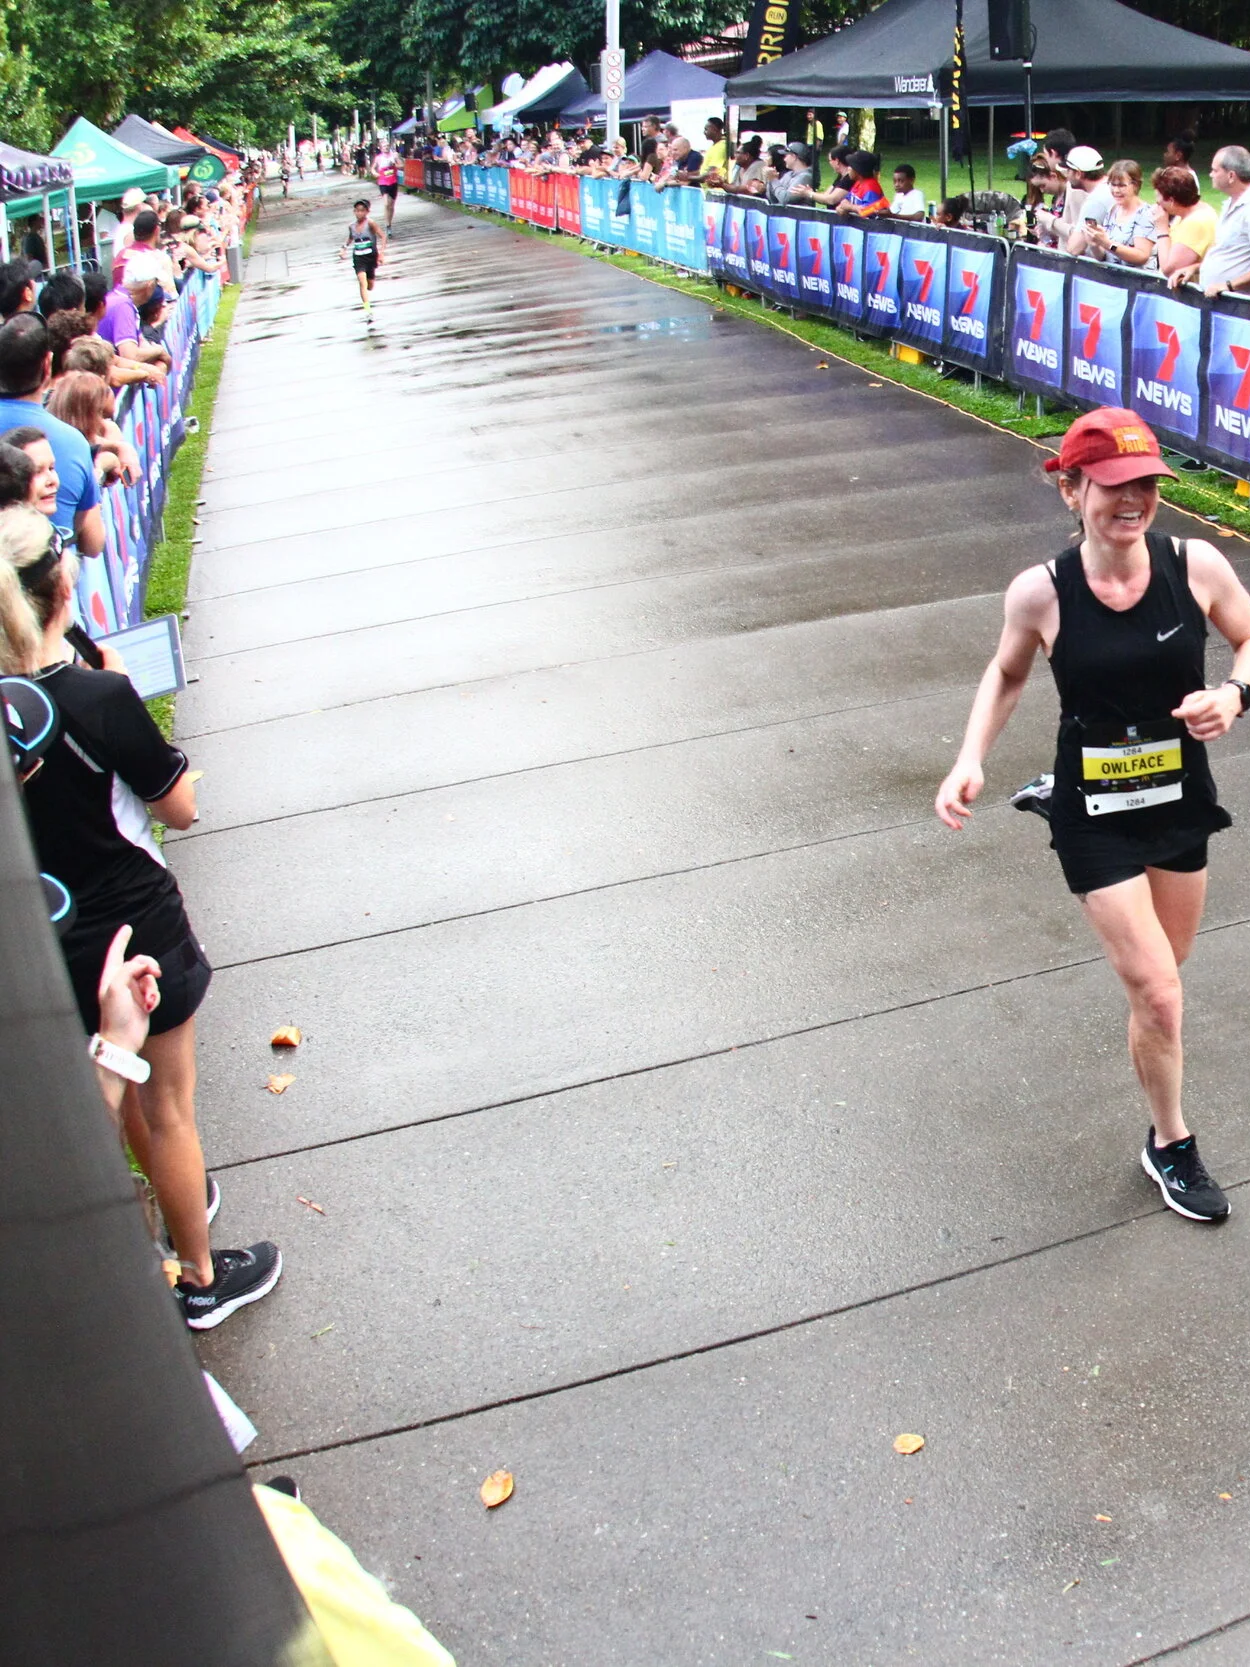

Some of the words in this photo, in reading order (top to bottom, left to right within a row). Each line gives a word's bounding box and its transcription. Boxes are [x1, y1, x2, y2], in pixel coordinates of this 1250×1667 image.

[767, 10, 785, 20] RUN
[757, 0, 790, 67] RRIO
[895, 76, 927, 93] Wanderer
[776, 232, 790, 268] 7
[808, 237, 822, 275] 7
[842, 243, 855, 283] 7
[773, 268, 796, 286] NEWS
[802, 275, 830, 294] NEWS
[876, 251, 890, 292] 7
[913, 259, 934, 303] 7
[837, 282, 860, 304] NEWS
[867, 293, 897, 314] NEWS
[961, 270, 980, 314] 7
[906, 302, 941, 327] NEWS
[1027, 289, 1046, 340] 7
[1078, 303, 1101, 359] 7
[1016, 338, 1058, 369] NEWS
[1155, 321, 1182, 382] 7
[1073, 356, 1116, 390] NEWS
[1136, 377, 1192, 417] NEWS
[1101, 755, 1164, 774] OWLFACE
[1122, 747, 1142, 756] 1284
[1126, 798, 1146, 807] 1284
